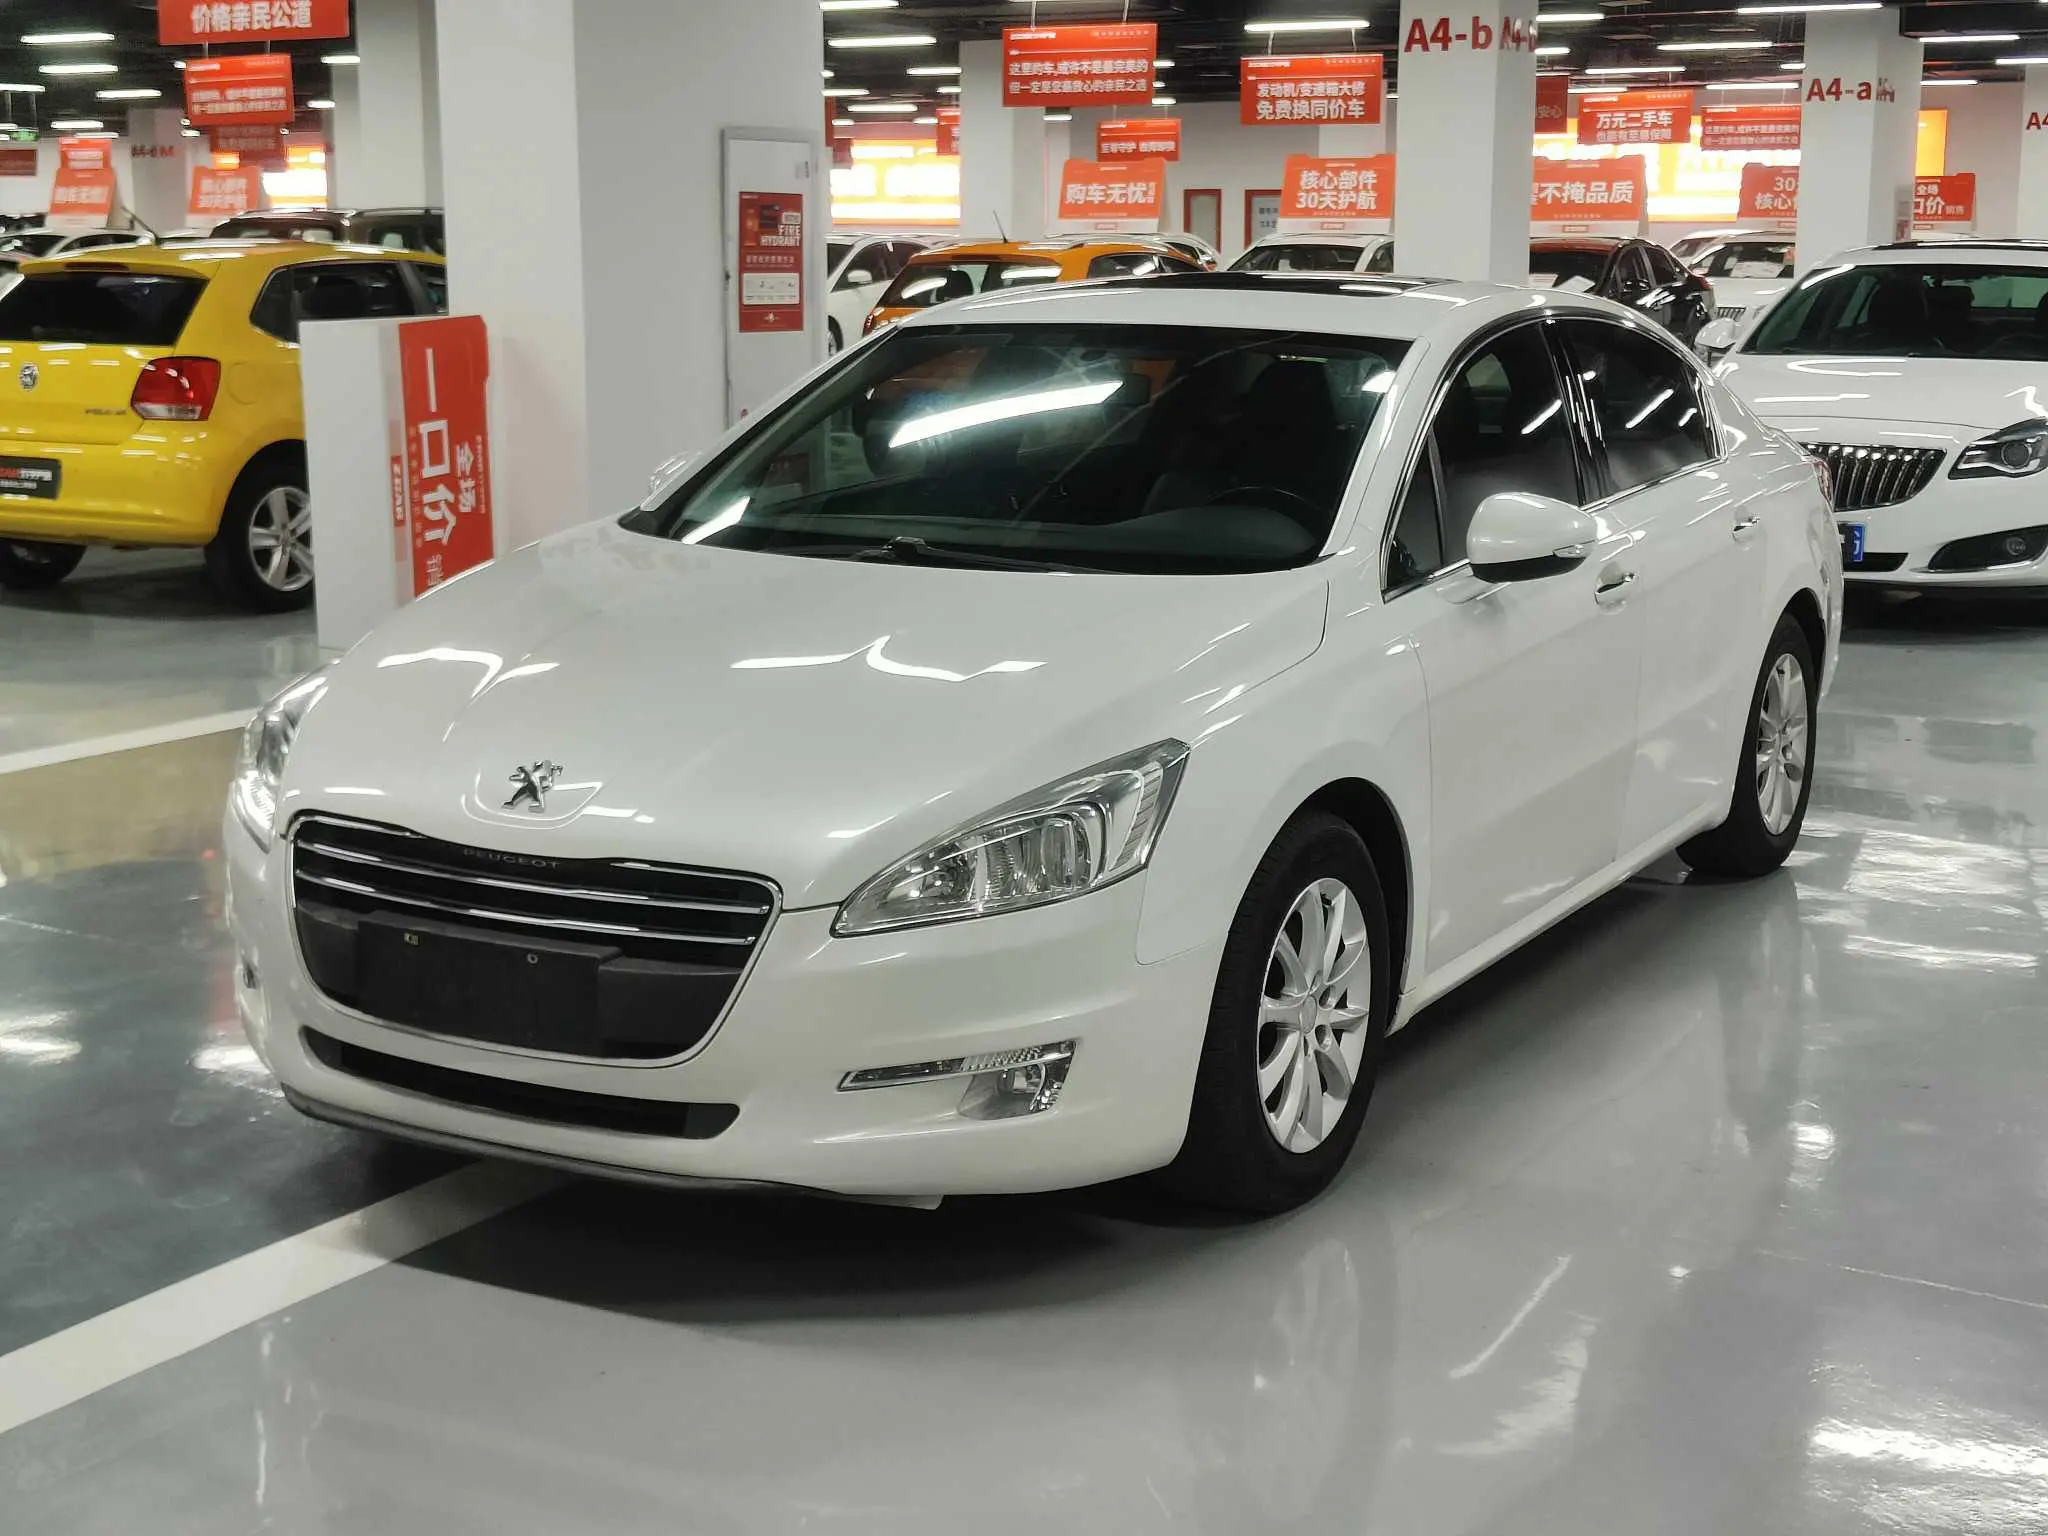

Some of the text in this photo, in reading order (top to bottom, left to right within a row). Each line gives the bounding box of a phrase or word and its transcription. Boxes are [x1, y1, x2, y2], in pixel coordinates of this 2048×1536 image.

[191, 1, 312, 33] 价格亲民公道
[1404, 16, 1493, 52] A4-b
[1257, 81, 1365, 98] 发动机/变速箱大修
[1806, 78, 1872, 101] A4-a
[1256, 99, 1365, 120] 免费换同价车
[1596, 111, 1673, 129] 万元二手车
[1299, 170, 1377, 190] 核心部件
[1773, 175, 1797, 192] 30
[1296, 190, 1377, 210] 30天护航
[1754, 192, 1797, 210] 核心
[418, 348, 457, 546] 一口价
[456, 441, 476, 513] 全场
[463, 847, 560, 870] PEUGEOT
